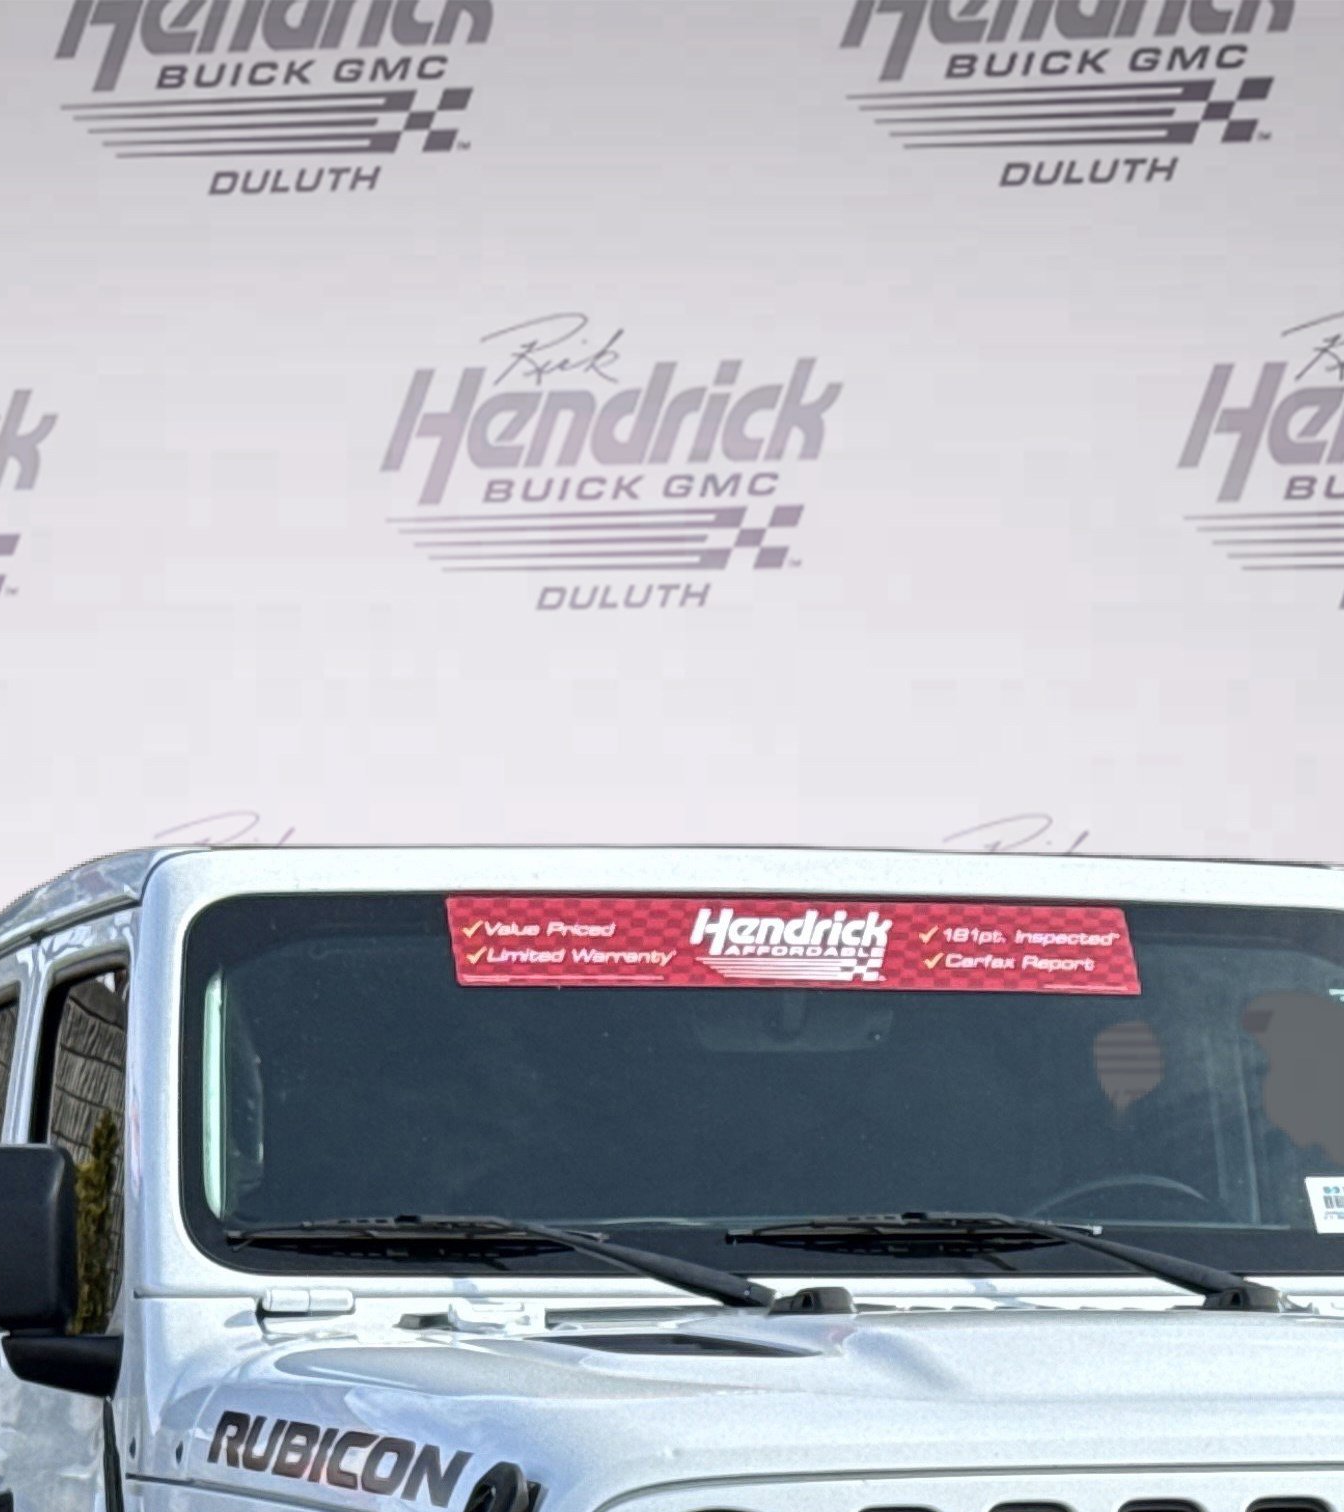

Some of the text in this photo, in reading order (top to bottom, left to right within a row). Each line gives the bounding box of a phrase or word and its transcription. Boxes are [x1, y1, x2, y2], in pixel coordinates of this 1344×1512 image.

[156, 55, 448, 89] BUICK GMC
[945, 44, 1248, 79] BUICK GMC
[208, 166, 381, 195] DULUTH
[999, 157, 1178, 187] DULUTH
[380, 357, 843, 505] Hendrick
[483, 472, 779, 503] BUICK GMC
[536, 583, 711, 611] DULUTH
[484, 921, 617, 937] Value Priced
[689, 908, 893, 956] Hendrick
[487, 948, 566, 964] Limited
[723, 945, 885, 958] AFFORDABLE
[944, 953, 1096, 972] Carfax Report
[207, 1410, 474, 1508] RUBICON
